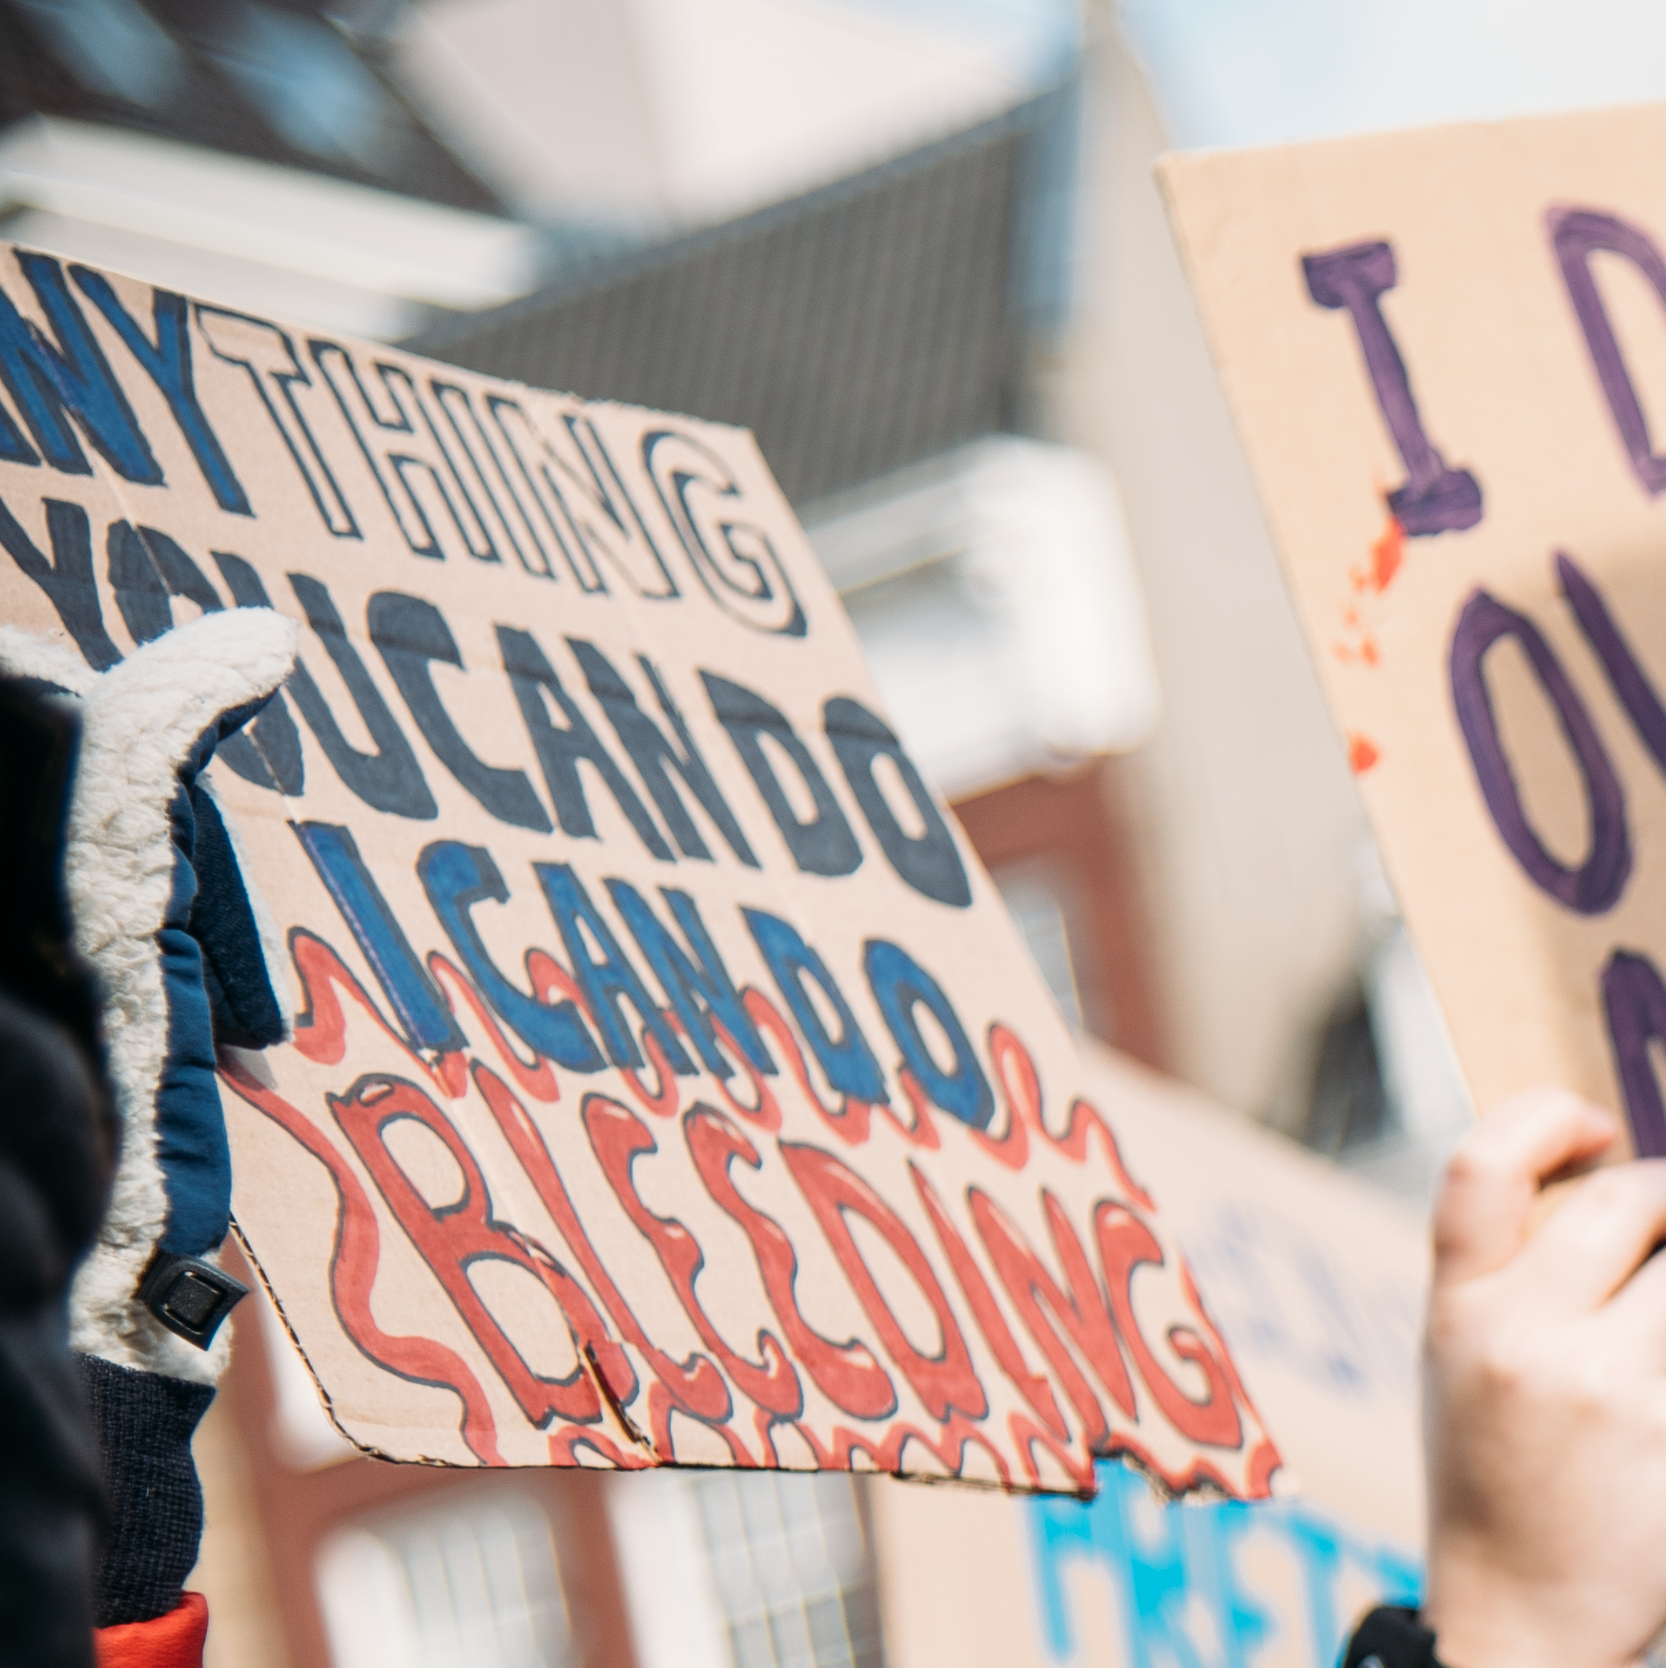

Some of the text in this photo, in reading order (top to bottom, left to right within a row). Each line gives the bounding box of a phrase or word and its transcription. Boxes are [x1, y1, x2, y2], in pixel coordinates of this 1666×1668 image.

[0, 246, 808, 637] NYTHING
[1299, 242, 1484, 538] I
[324, 1058, 1247, 1452] BLEEDING
